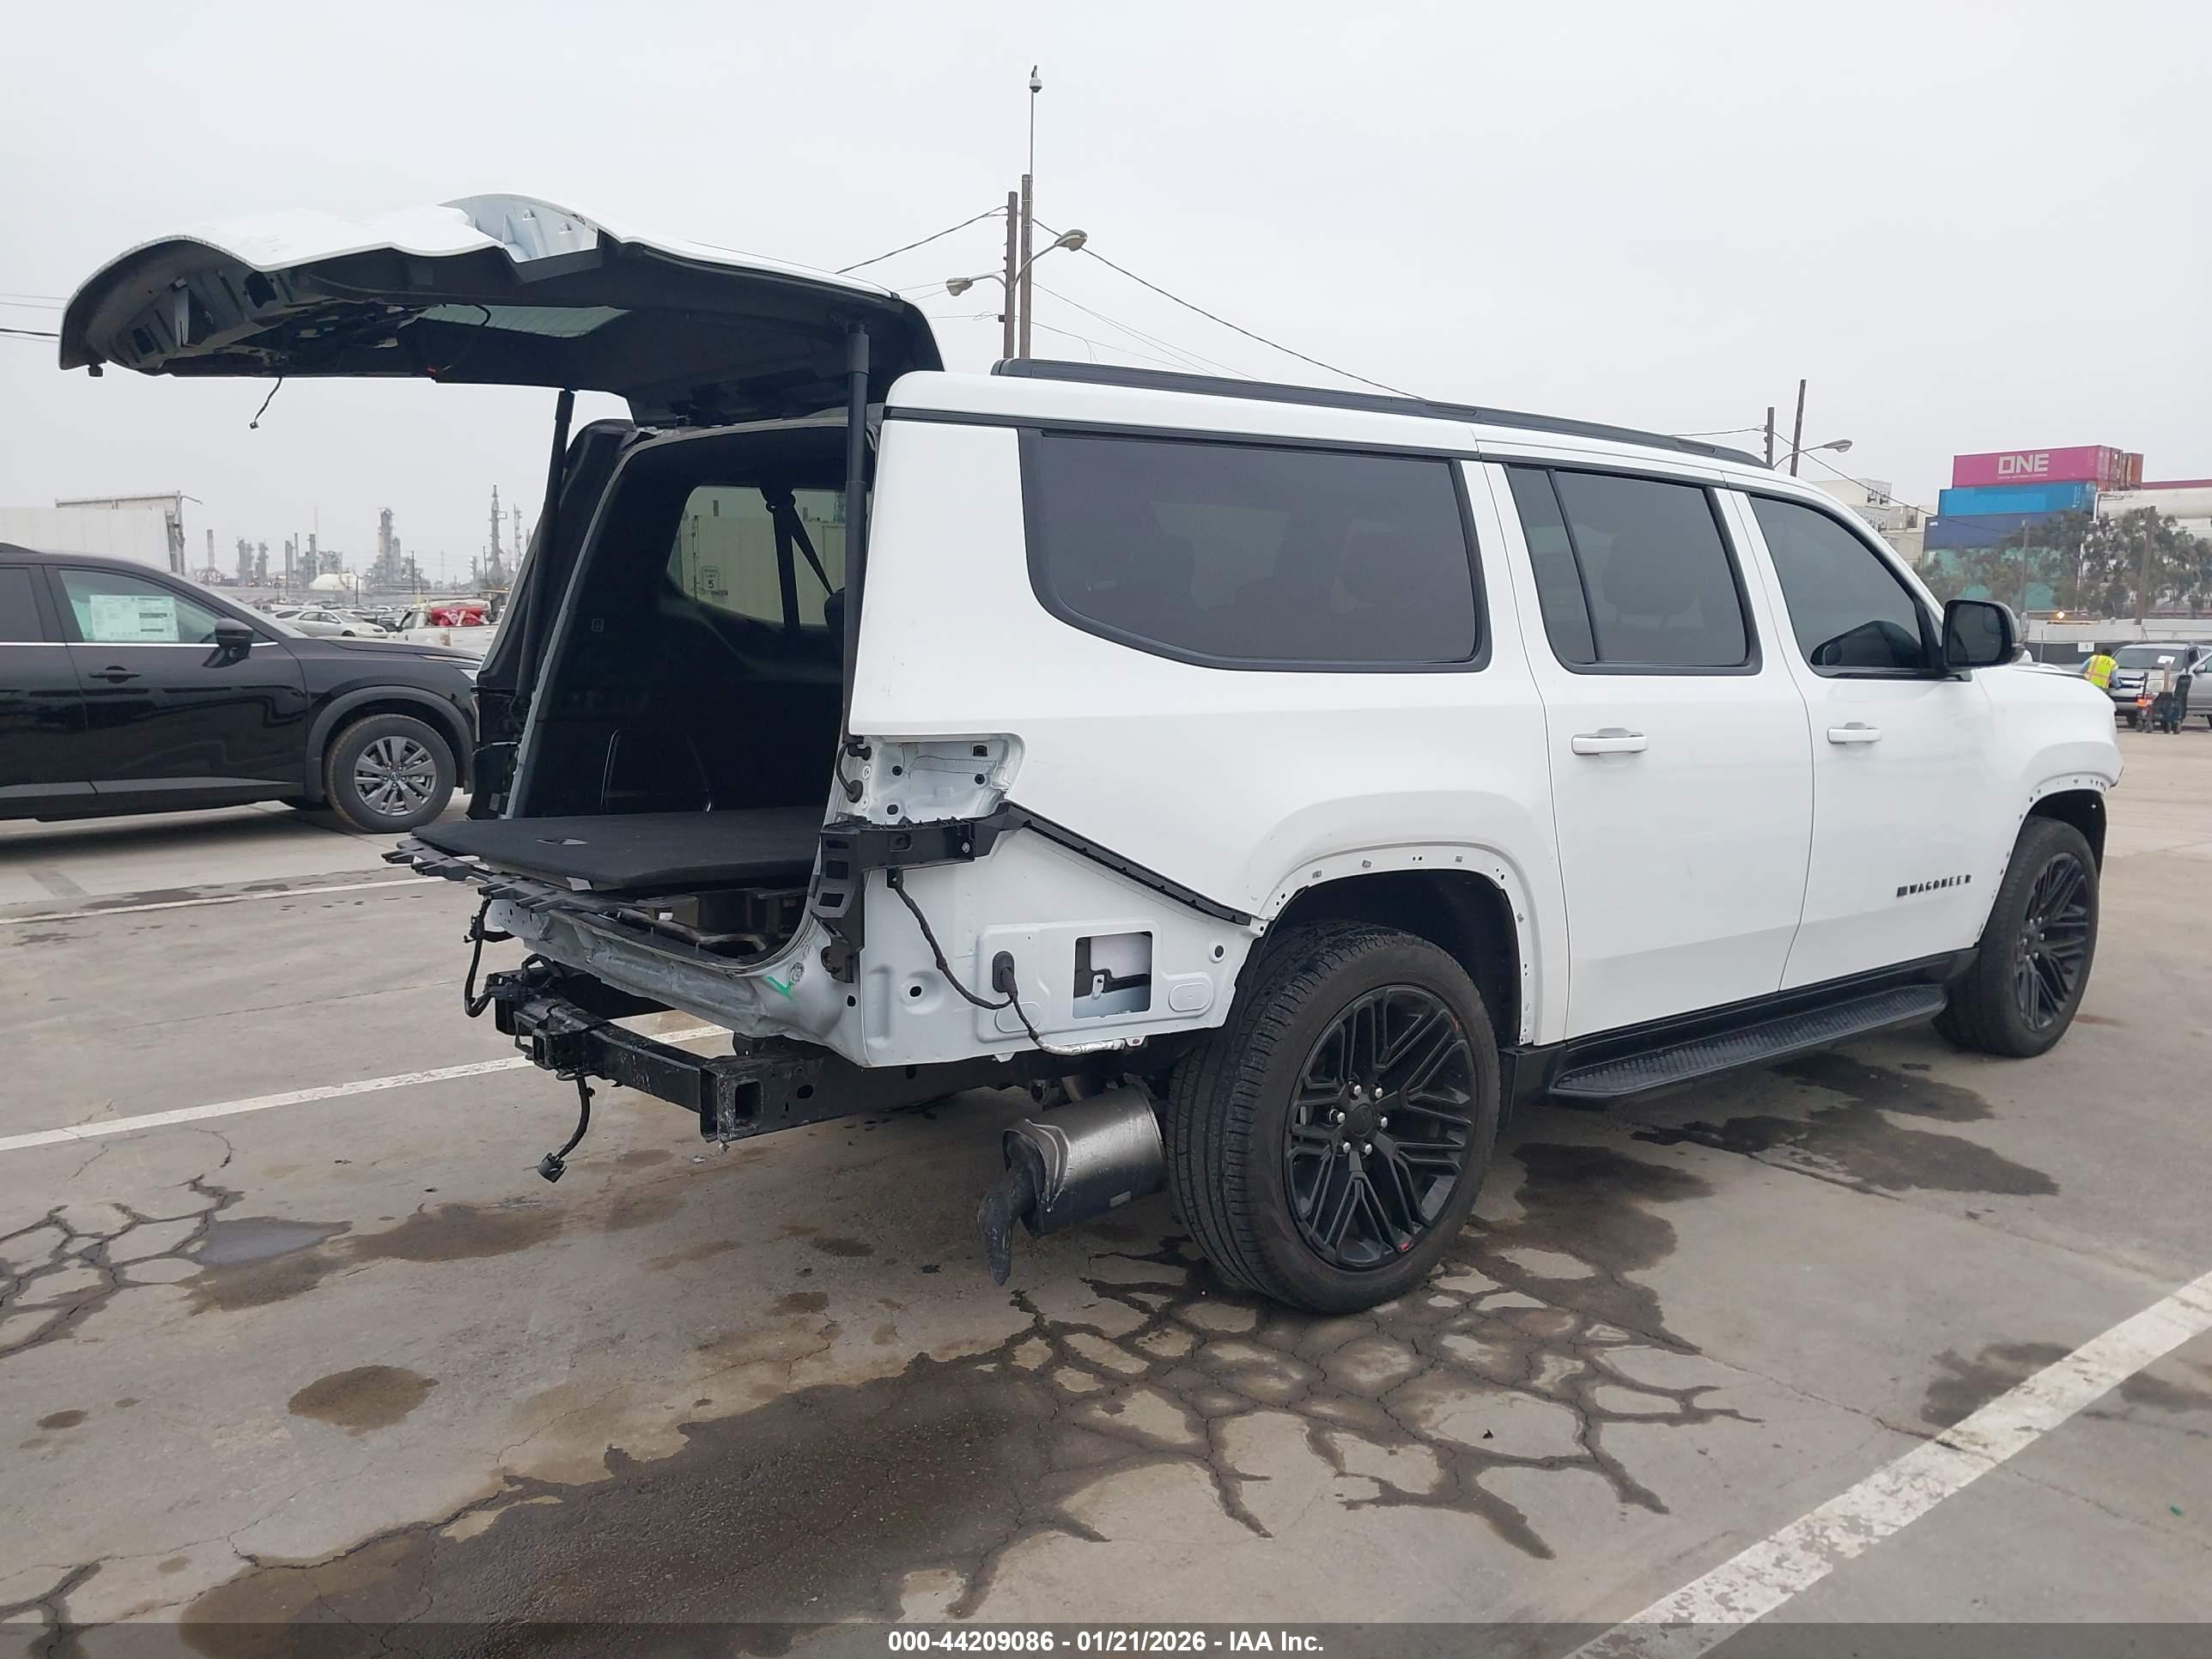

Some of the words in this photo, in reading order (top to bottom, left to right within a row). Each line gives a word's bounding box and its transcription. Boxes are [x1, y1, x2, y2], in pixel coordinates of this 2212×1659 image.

[1997, 453, 2050, 475] ONE
[708, 580, 714, 589] 5
[1909, 874, 1972, 895] WAGONEER
